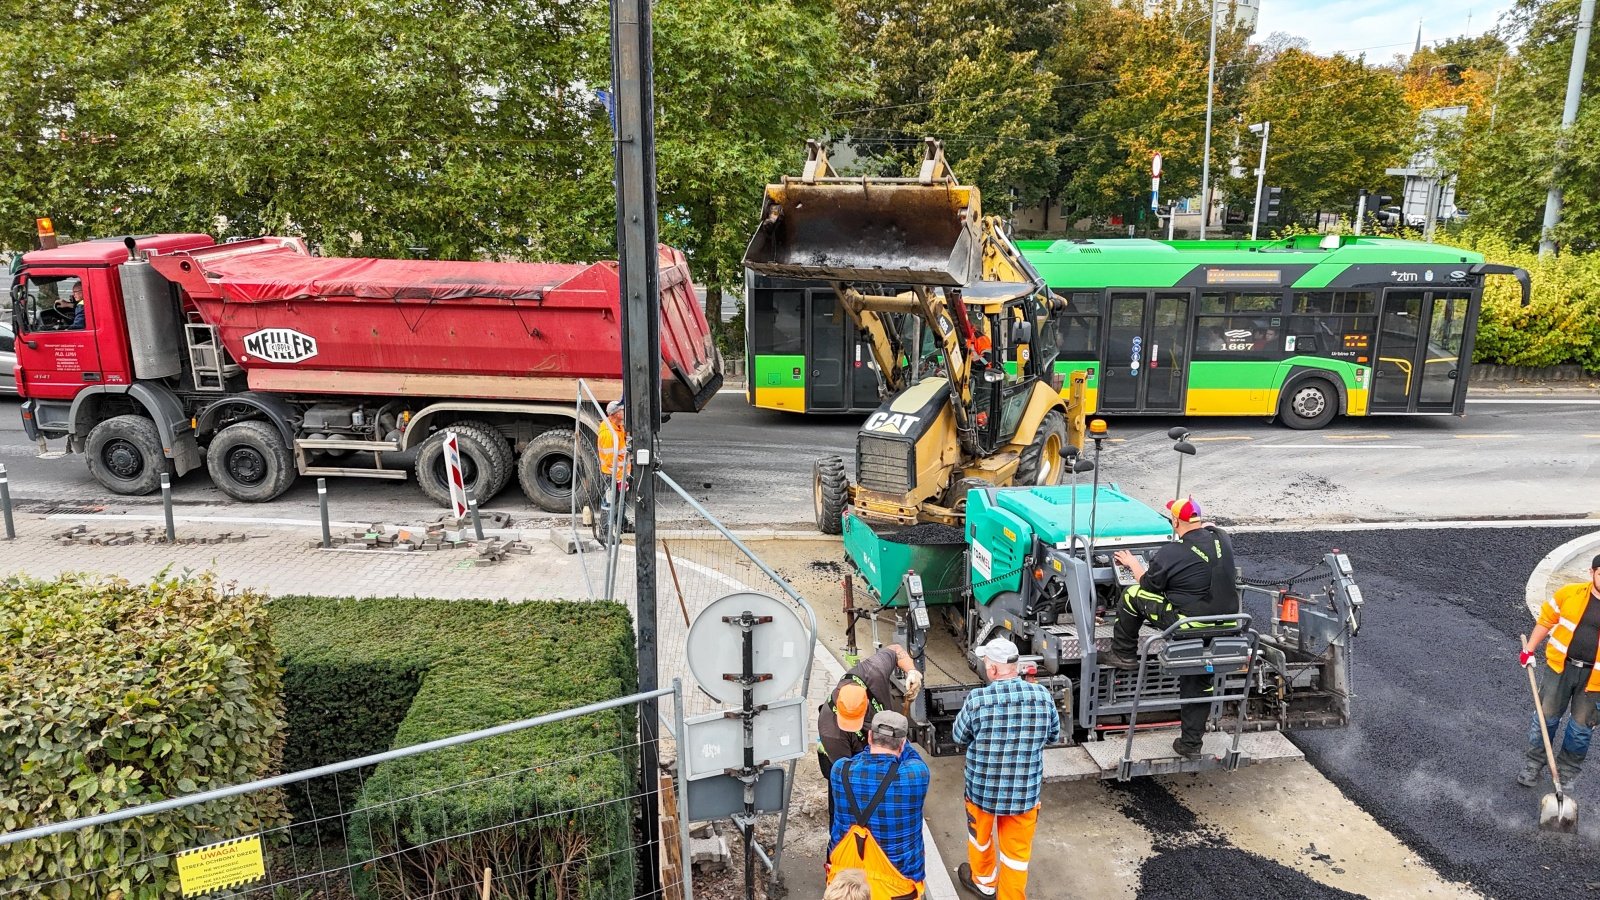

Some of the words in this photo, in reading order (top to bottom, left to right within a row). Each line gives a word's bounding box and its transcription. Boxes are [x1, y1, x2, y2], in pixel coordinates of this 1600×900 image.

[247, 331, 314, 359] MEILLER
[271, 343, 291, 352] KIPPER
[1220, 343, 1255, 351] 1667
[865, 411, 921, 436] CAT
[182, 862, 204, 871] STREFA
[206, 855, 236, 866] OCHRONY
[236, 849, 258, 858] DRZEW
[200, 846, 239, 861] UWAGA!
